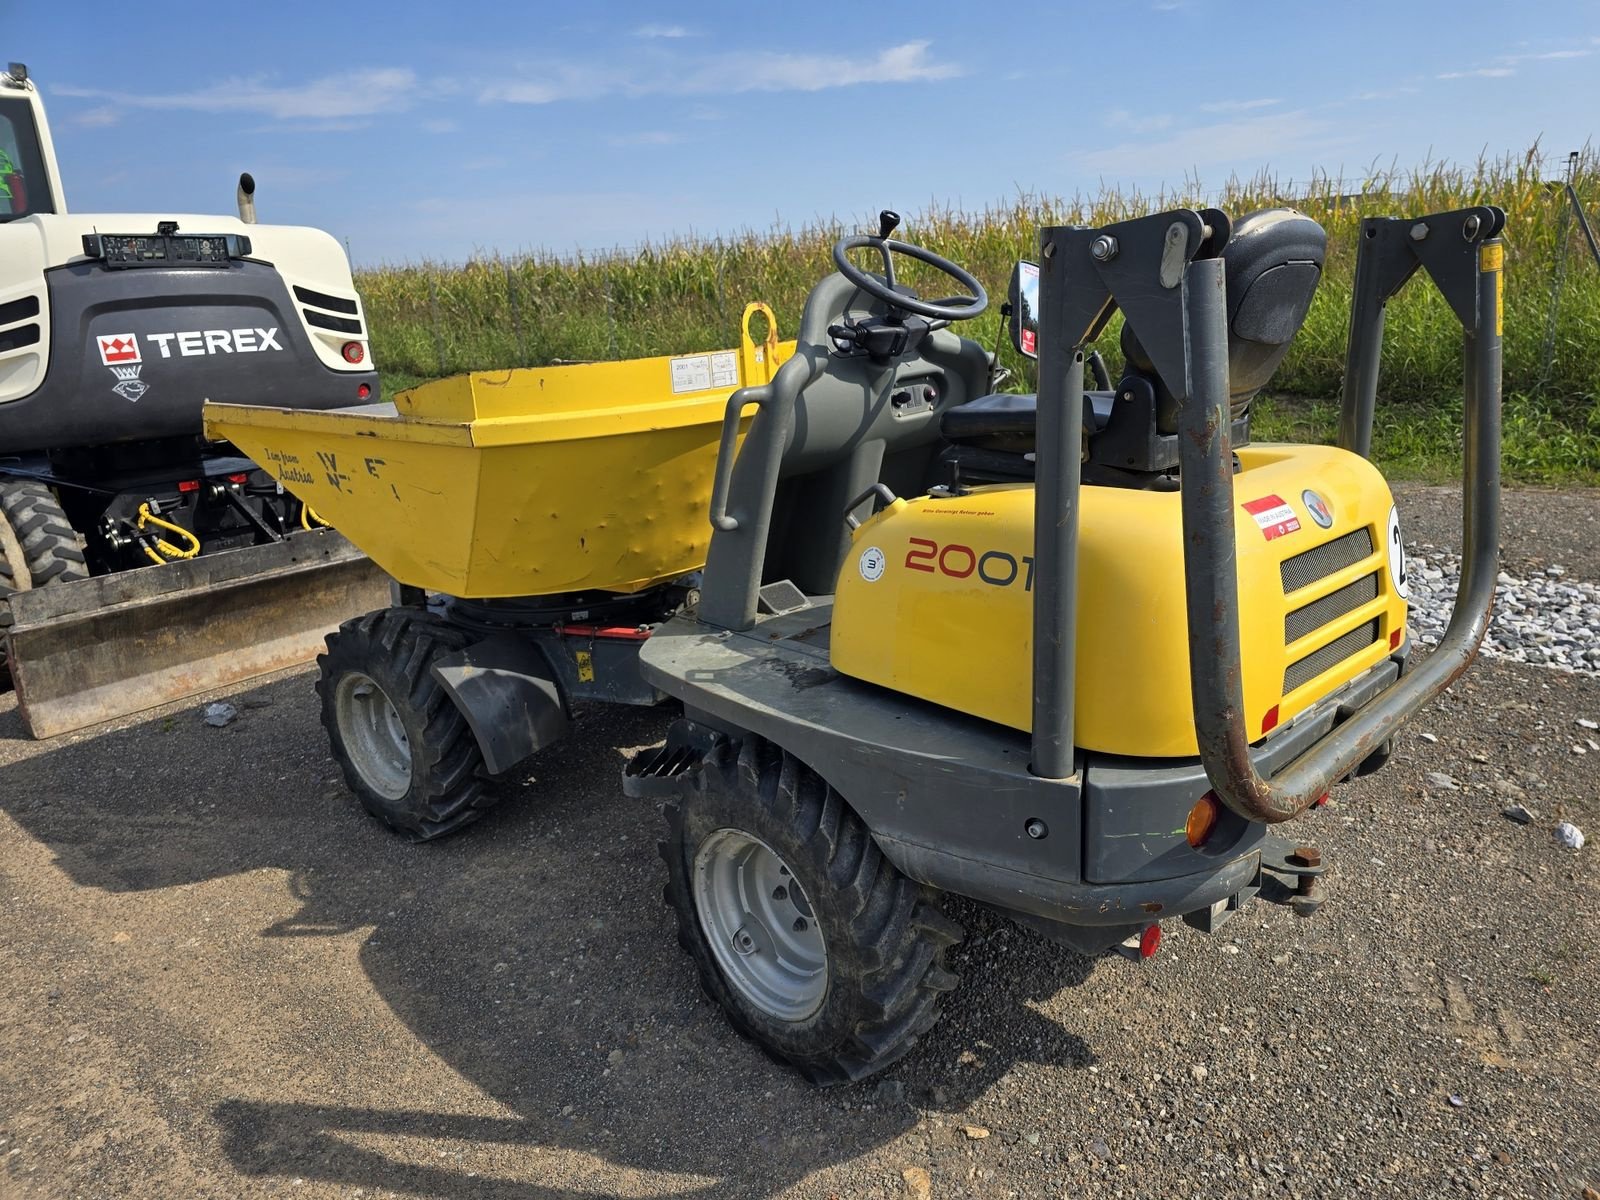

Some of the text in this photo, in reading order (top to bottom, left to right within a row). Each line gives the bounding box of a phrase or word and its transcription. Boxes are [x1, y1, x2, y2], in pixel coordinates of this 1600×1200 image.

[147, 328, 283, 358] TEREX
[280, 450, 299, 465] from
[278, 464, 314, 484] Austria
[905, 537, 1034, 592] 2001
